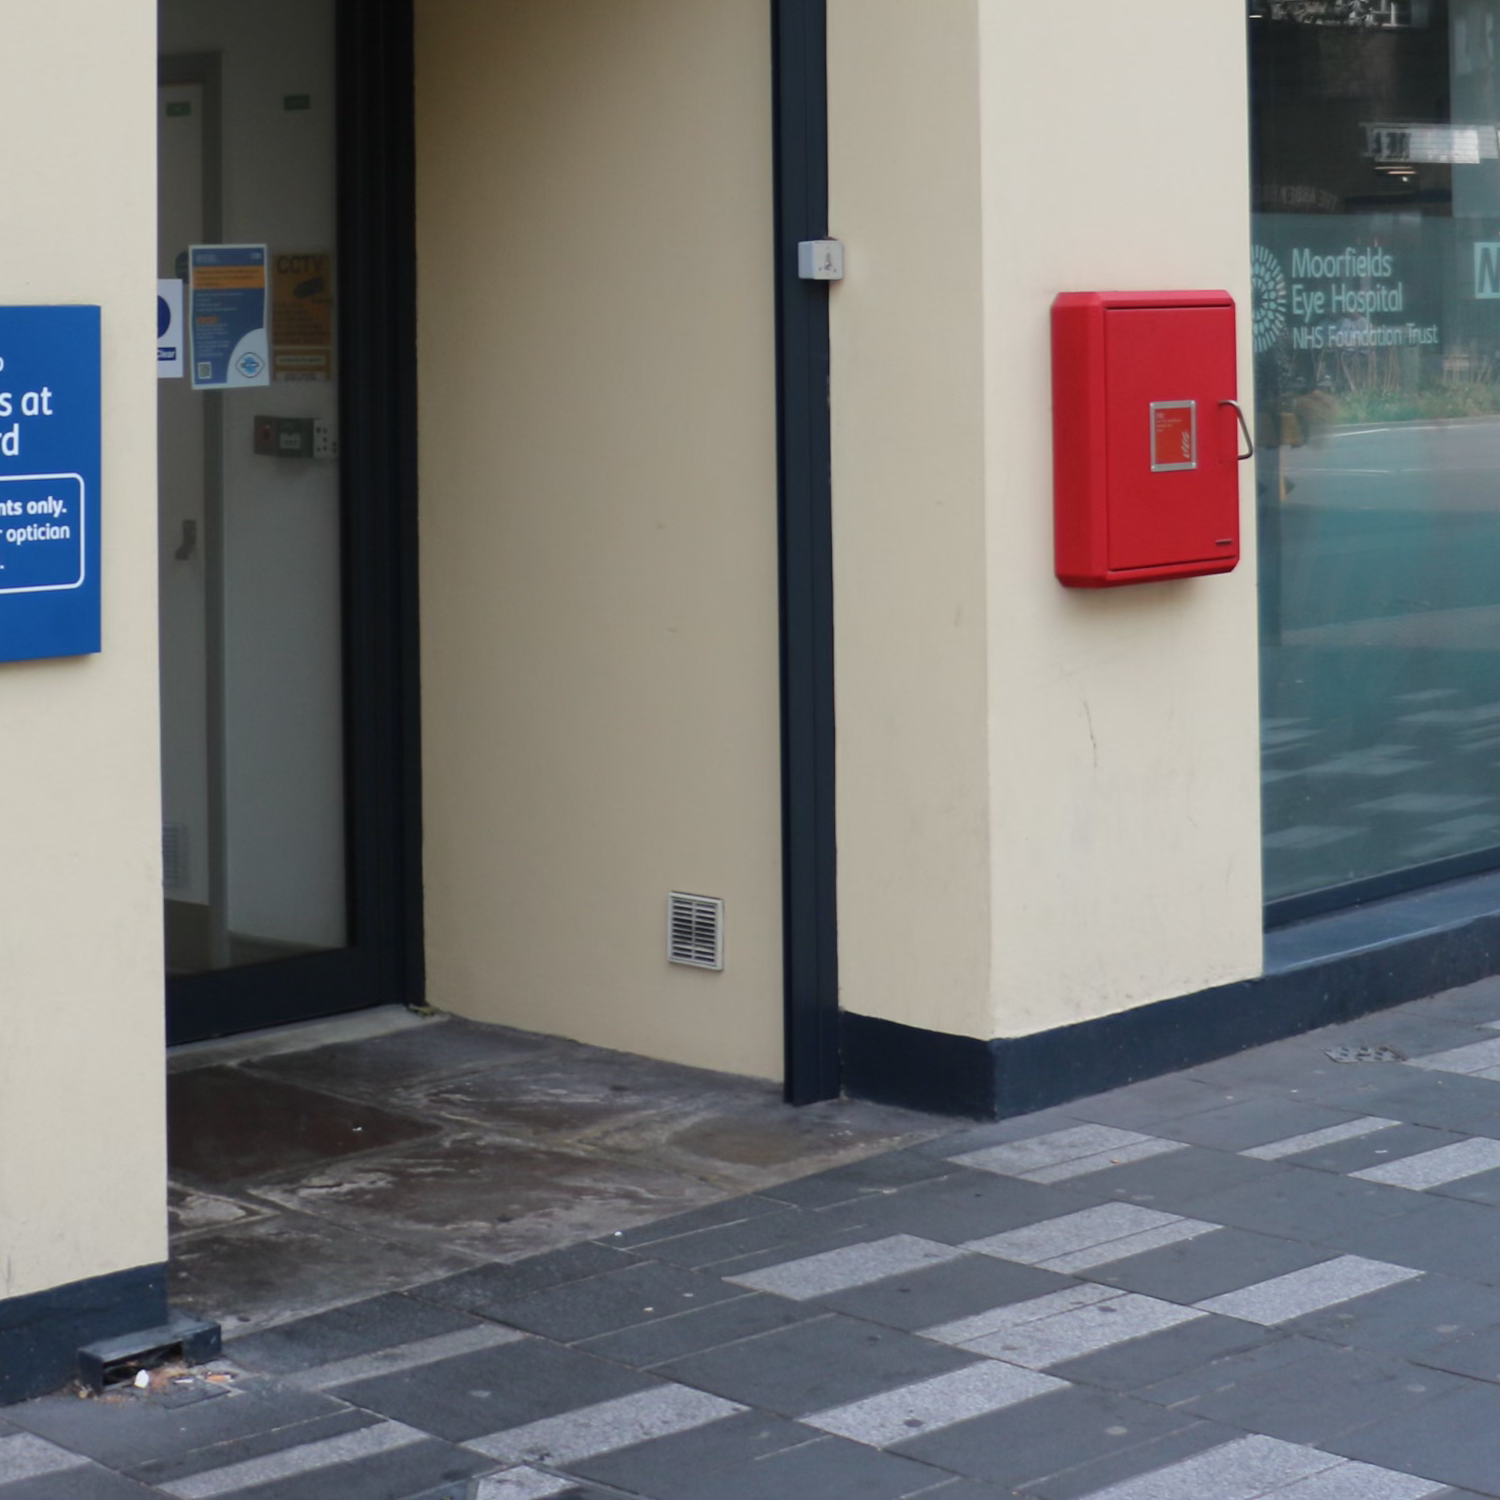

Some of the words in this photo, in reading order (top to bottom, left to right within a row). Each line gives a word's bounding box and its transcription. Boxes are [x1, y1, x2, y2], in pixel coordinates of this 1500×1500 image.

[277, 255, 322, 274] CCTV
[1291, 246, 1393, 278] Moorfields
[1292, 284, 1325, 323] Eye
[1331, 281, 1403, 320] Hospital
[1292, 326, 1324, 349] NHS
[1328, 323, 1402, 349] Foundation
[1406, 322, 1439, 345] Trust
[21, 386, 53, 417] at
[26, 496, 67, 521] only.
[6, 523, 71, 546] optician
